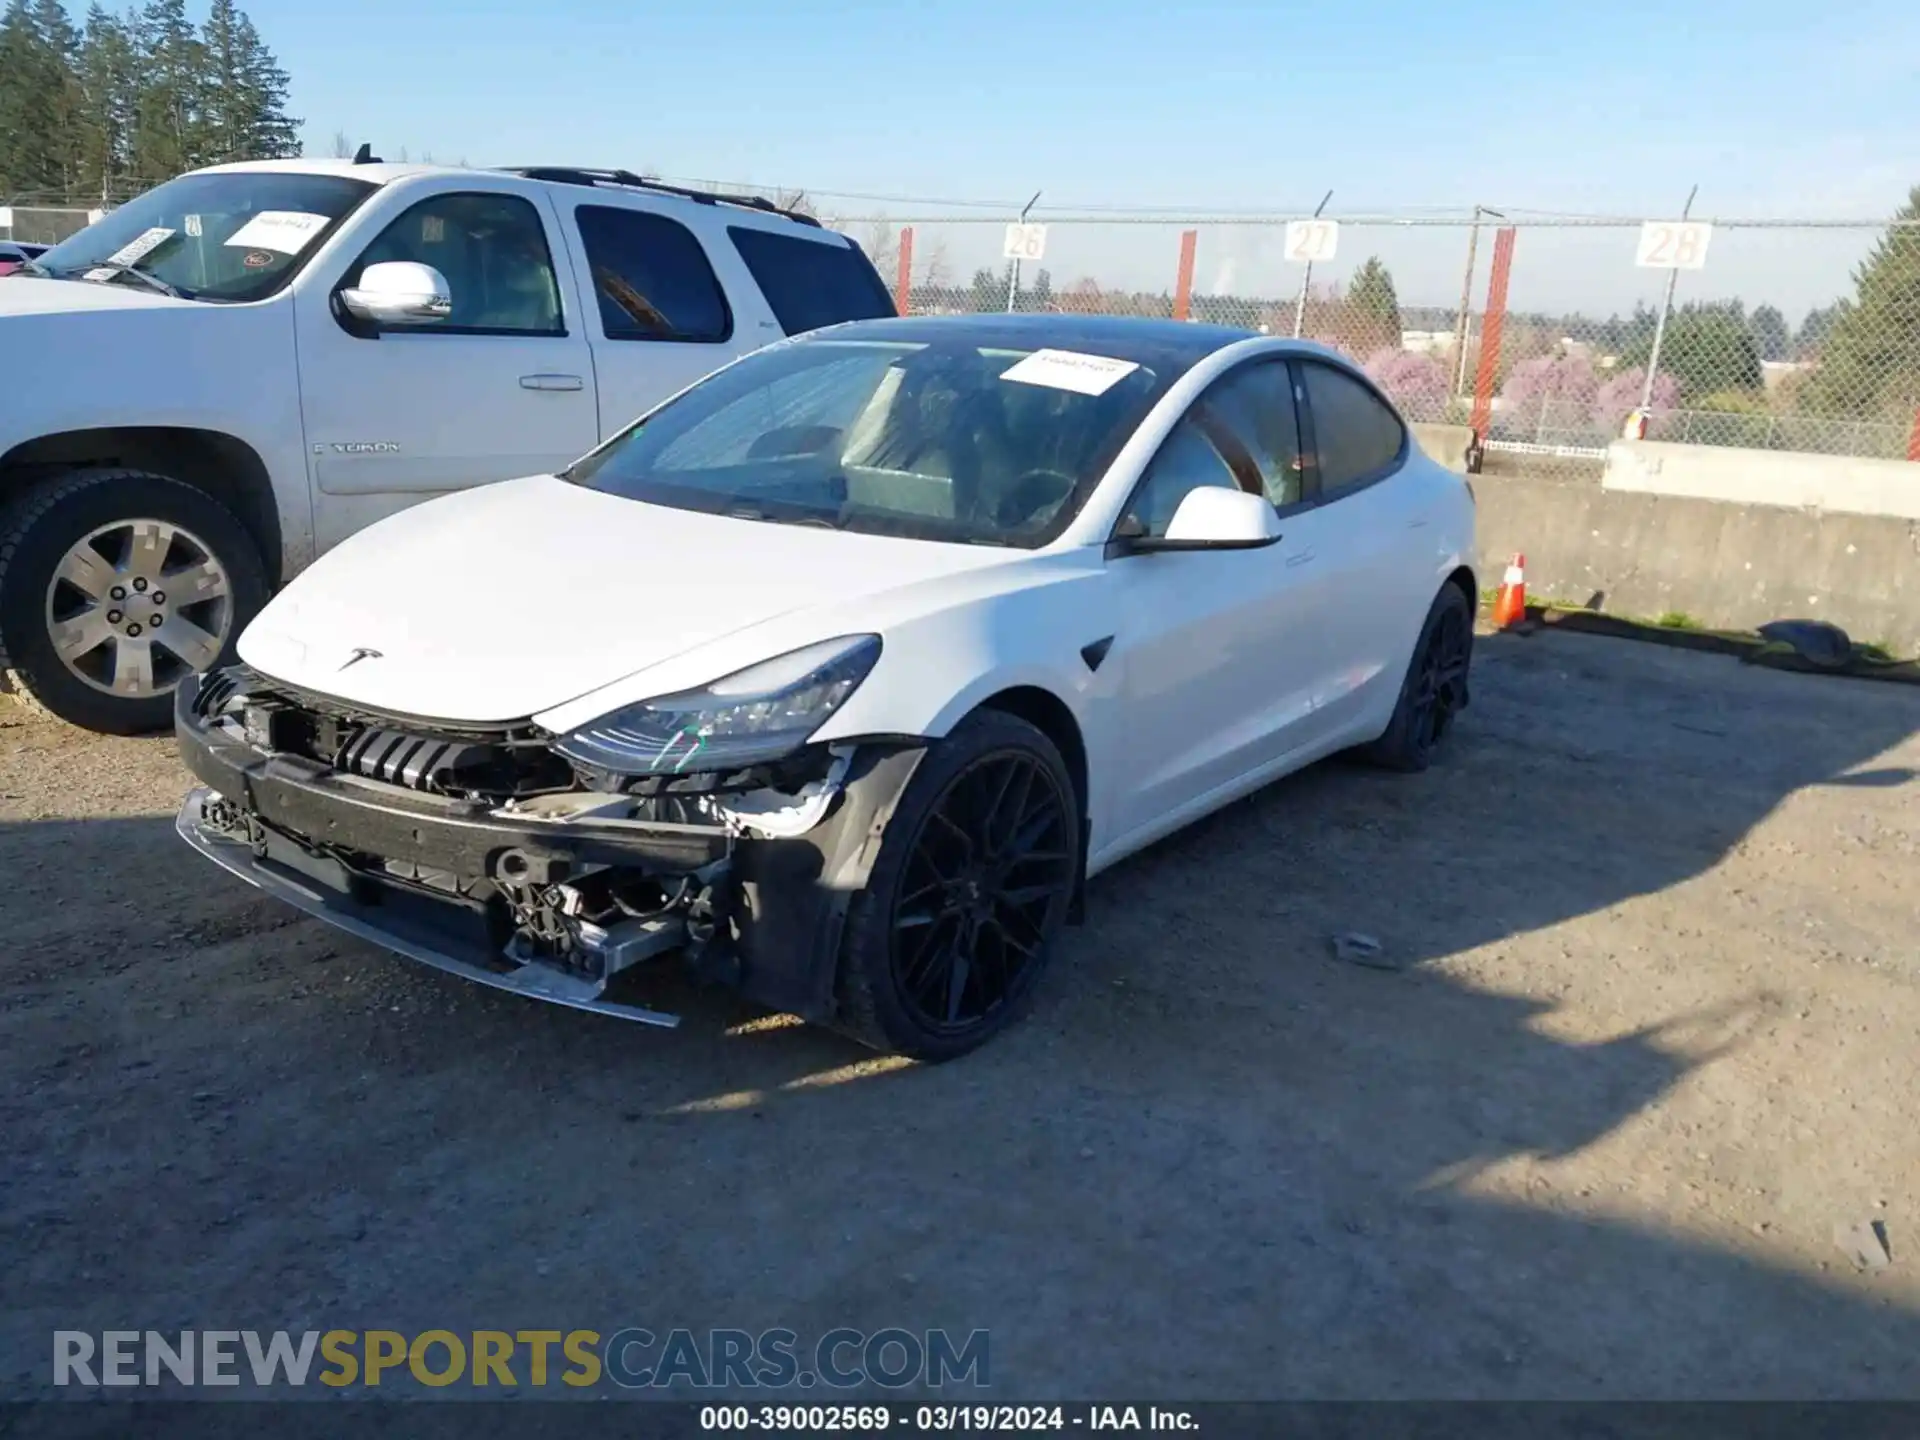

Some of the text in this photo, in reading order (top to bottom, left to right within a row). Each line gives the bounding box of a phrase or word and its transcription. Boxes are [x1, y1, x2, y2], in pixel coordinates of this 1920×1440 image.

[1009, 226, 1042, 256] 26
[1292, 223, 1330, 257] 27
[1644, 226, 1702, 264] 28
[330, 441, 401, 454] YUKON
